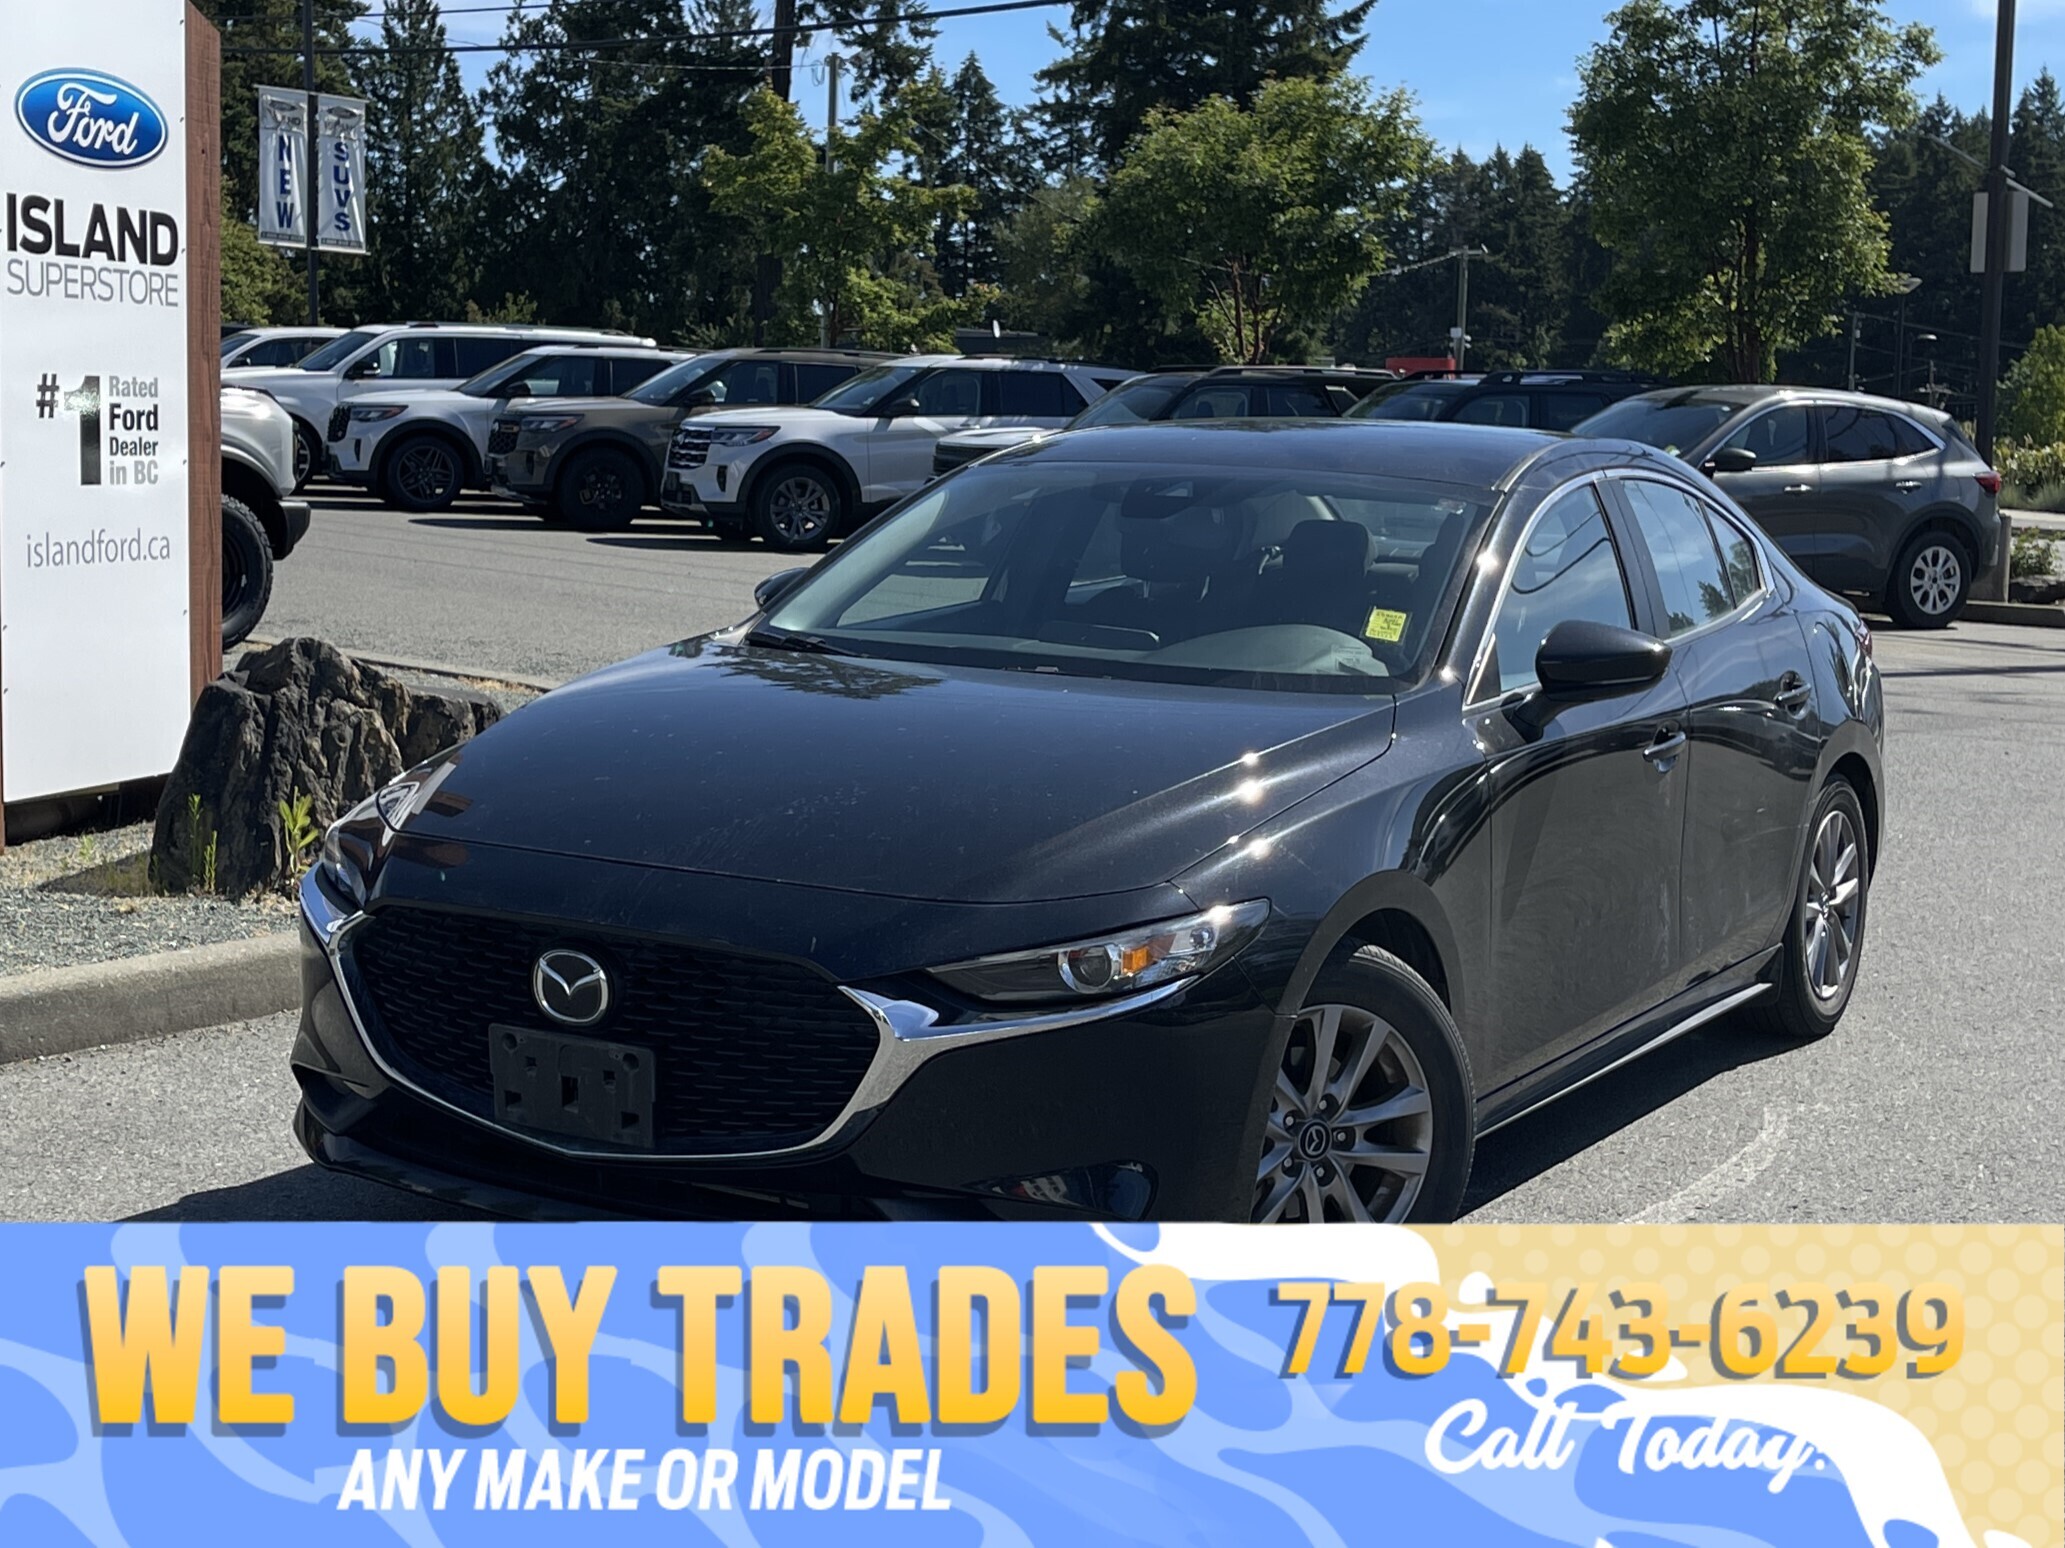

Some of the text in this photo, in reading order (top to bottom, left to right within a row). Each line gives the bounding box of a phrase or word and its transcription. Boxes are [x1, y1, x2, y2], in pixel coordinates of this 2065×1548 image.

[47, 82, 139, 155] Ford
[276, 134, 295, 229] NEW
[333, 141, 351, 232] SUVS
[6, 192, 179, 267] ISLAND
[6, 258, 179, 307] SUPERSTORE
[108, 375, 158, 398] Rated
[36, 373, 102, 486] #1
[108, 403, 159, 431] Ford
[109, 436, 159, 457] Dealer
[109, 460, 159, 485] in BC
[27, 527, 171, 568] islandford.ca
